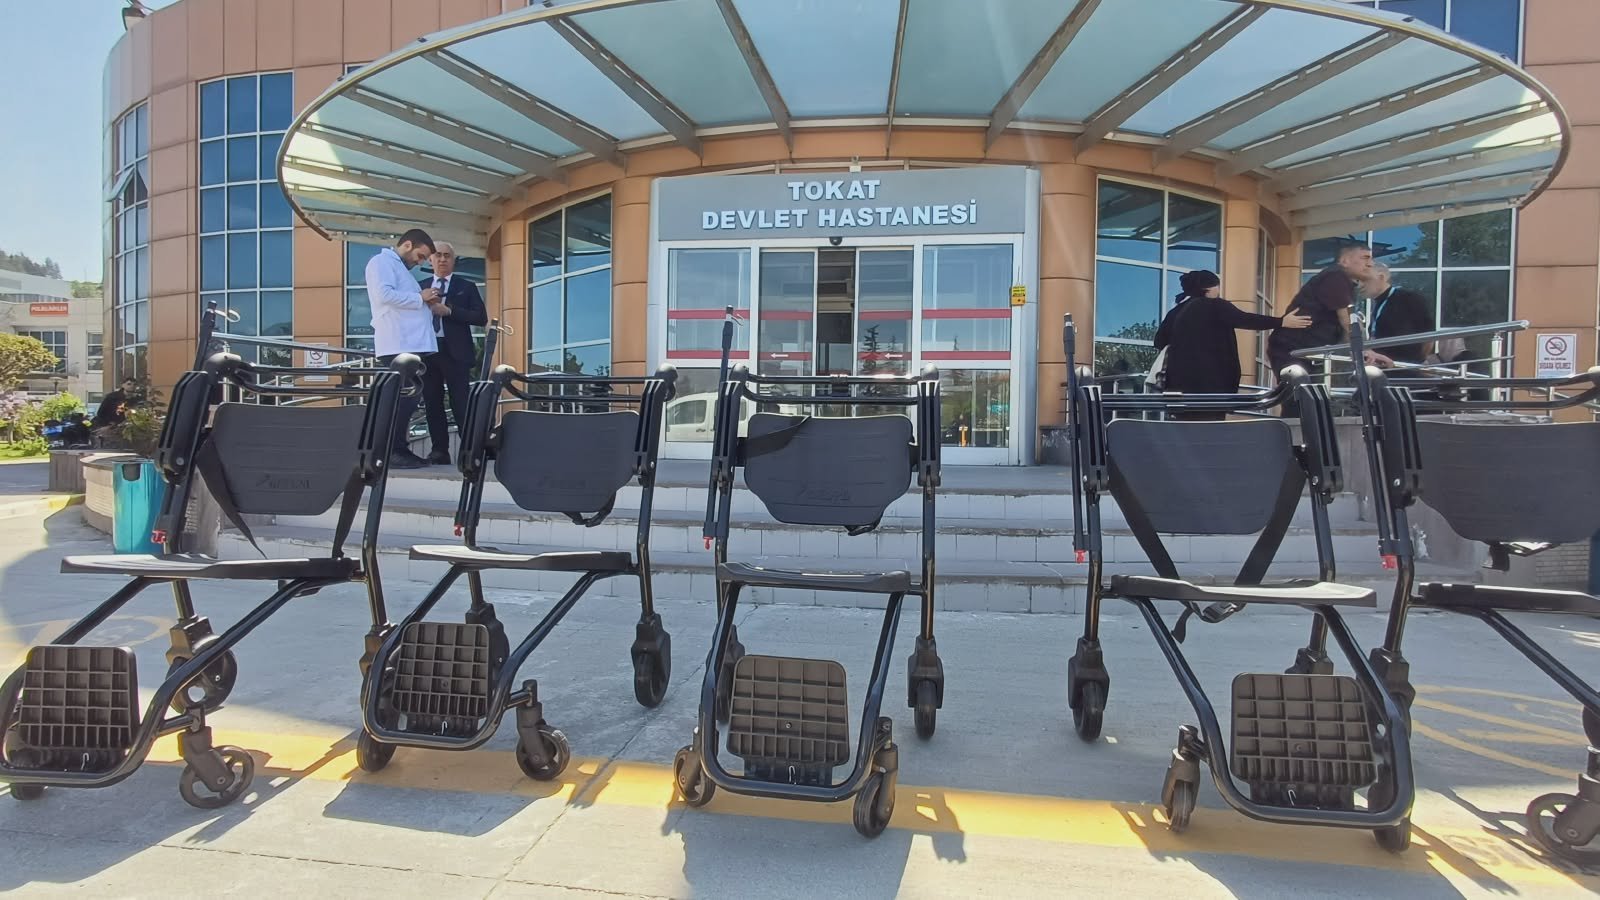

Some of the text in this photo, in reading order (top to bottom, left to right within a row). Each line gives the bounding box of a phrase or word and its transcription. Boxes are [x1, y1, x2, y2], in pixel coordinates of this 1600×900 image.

[788, 179, 881, 201] TOKAT
[702, 199, 978, 230] DEVLET HASTANESİ
